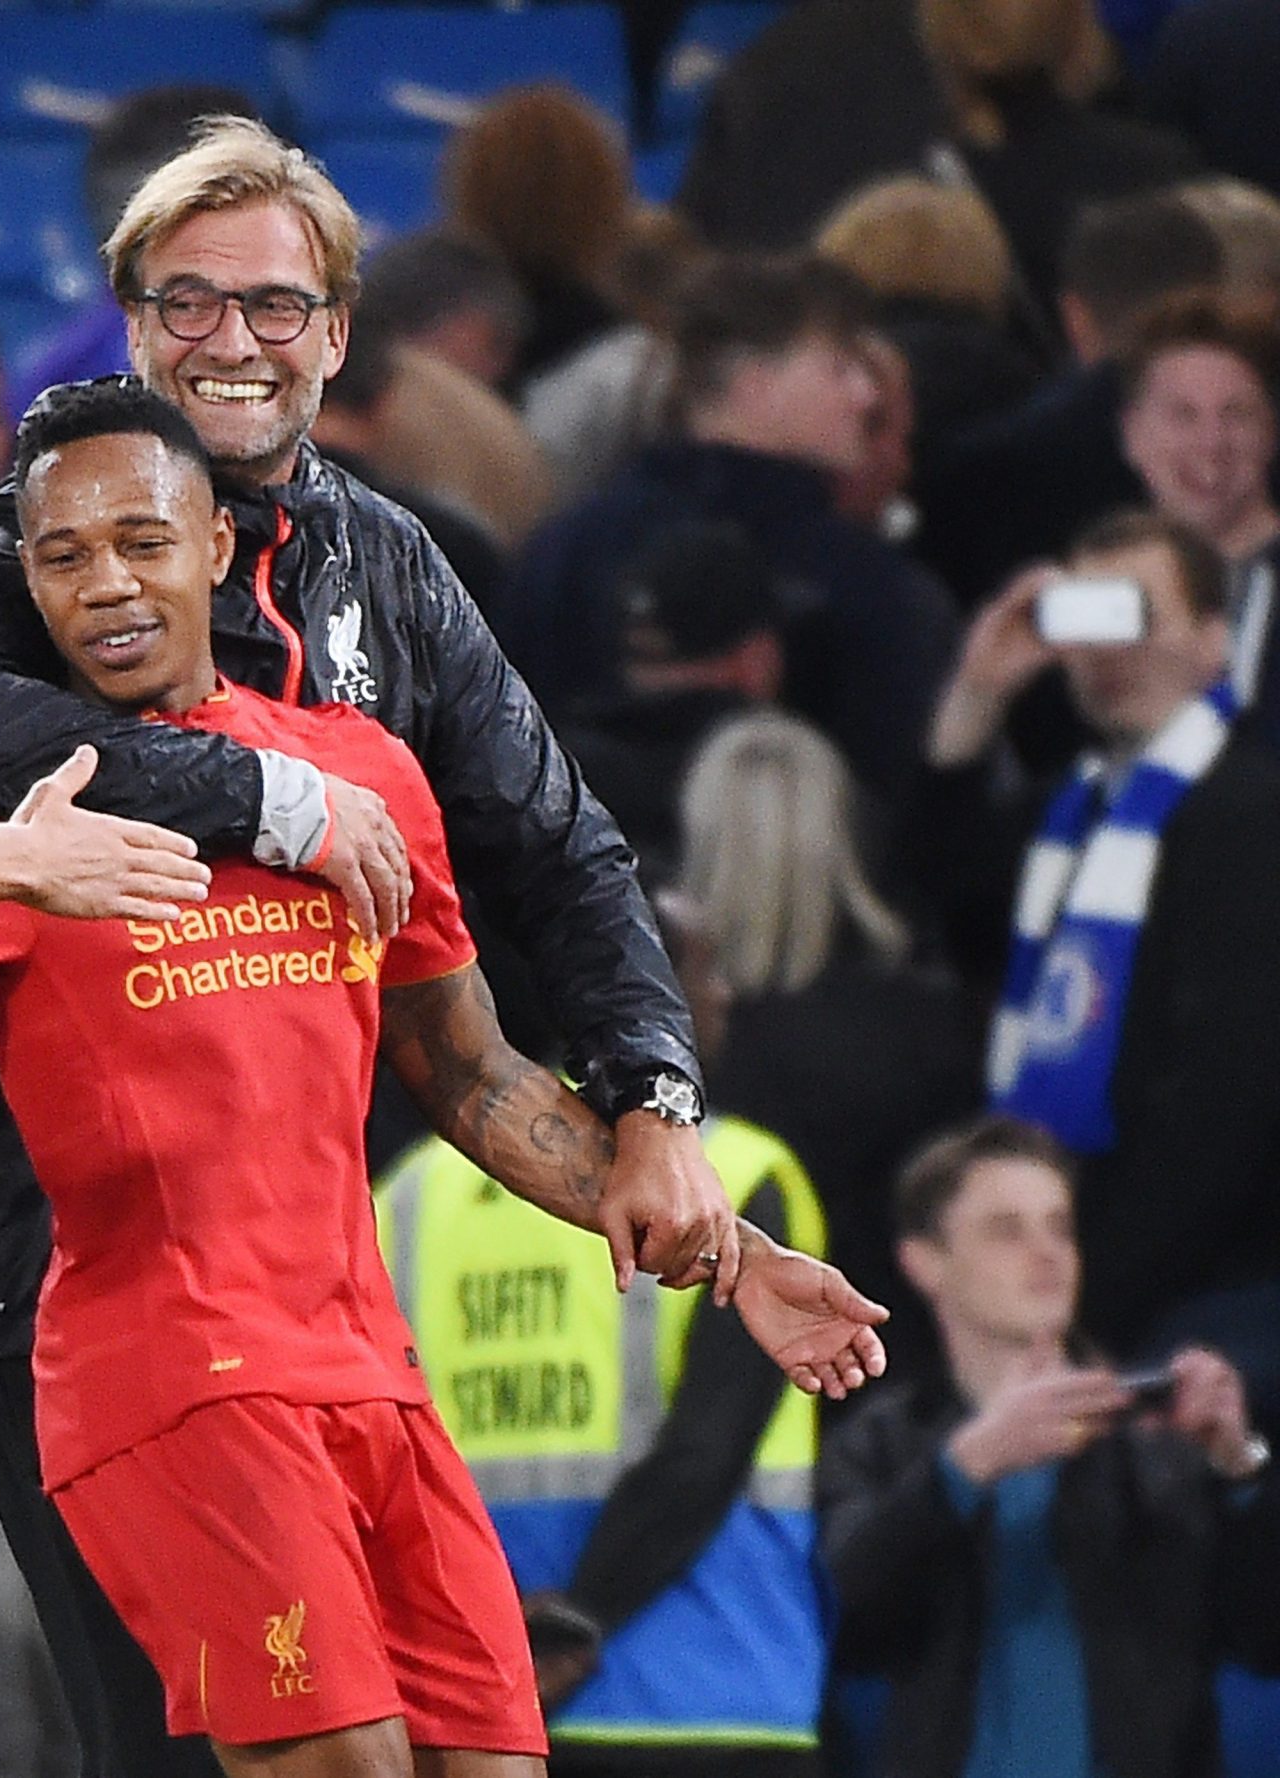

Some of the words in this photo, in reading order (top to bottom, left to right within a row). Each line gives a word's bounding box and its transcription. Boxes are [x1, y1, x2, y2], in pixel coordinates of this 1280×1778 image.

[127, 894, 333, 953] Standard
[125, 940, 336, 1009] Chartered
[270, 1674, 315, 1698] LFC
